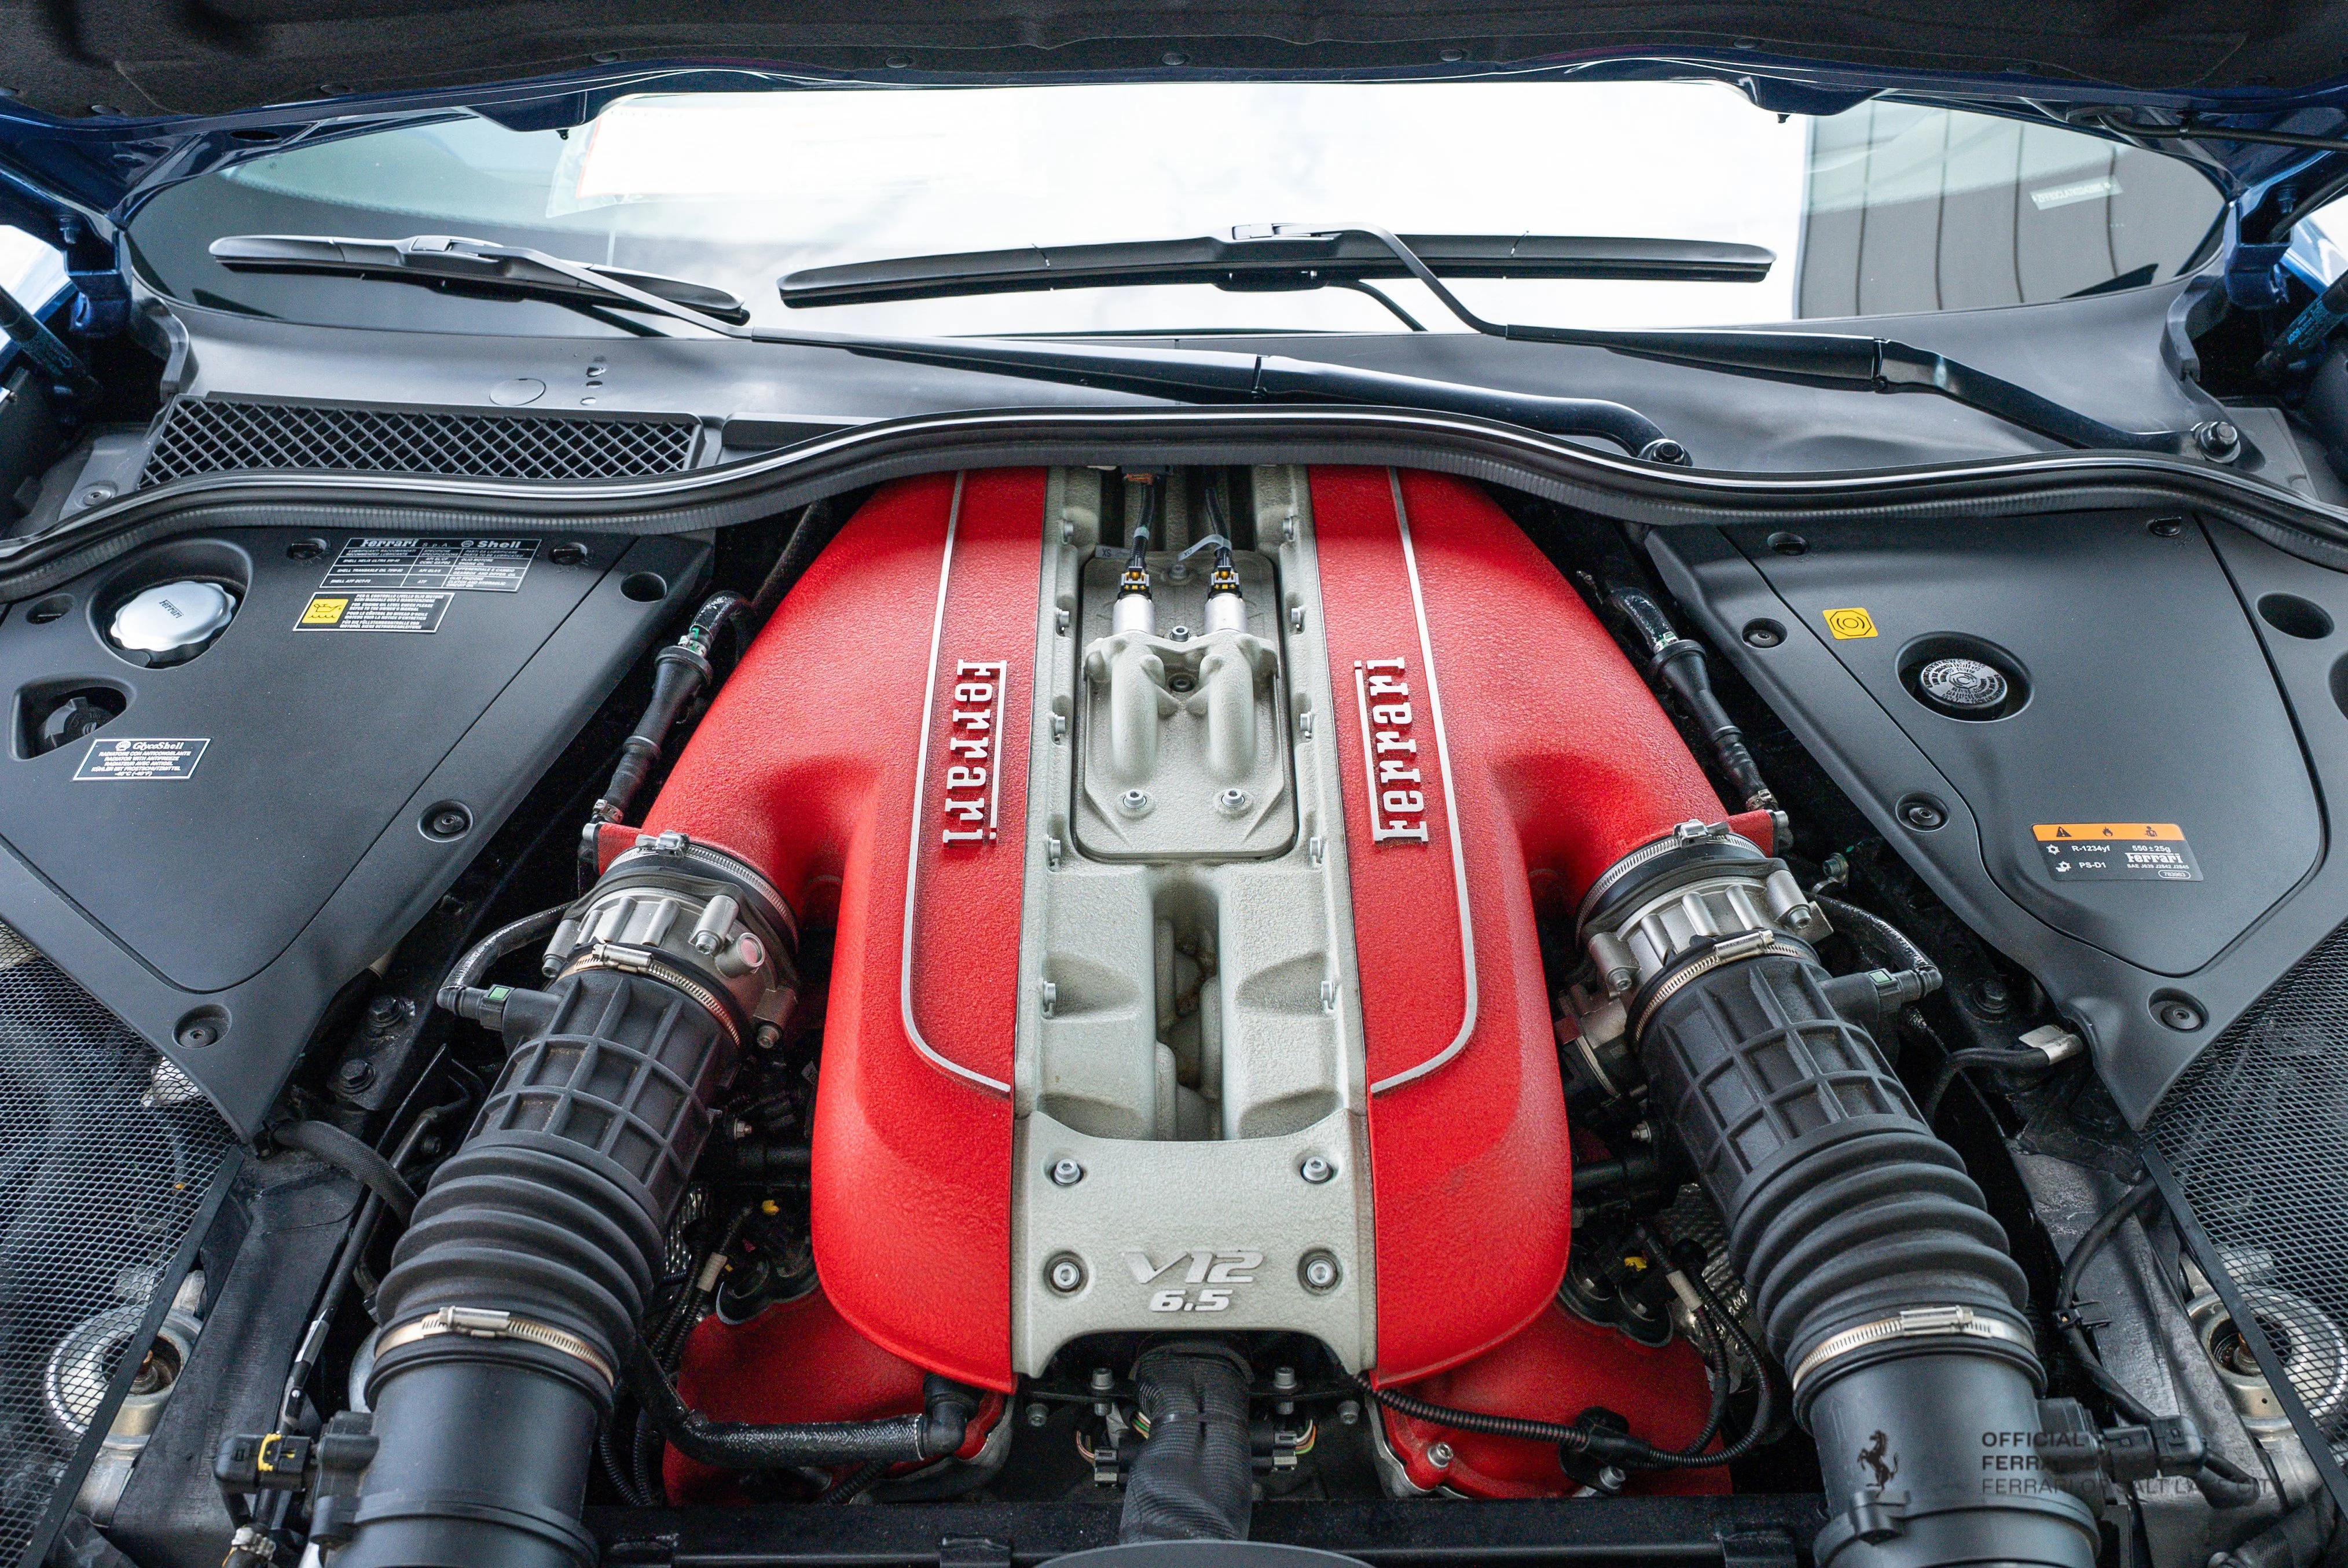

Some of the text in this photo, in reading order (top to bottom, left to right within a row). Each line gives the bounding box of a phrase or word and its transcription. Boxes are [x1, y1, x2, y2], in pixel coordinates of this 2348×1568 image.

[359, 539, 419, 547] Ferrari
[1102, 548, 1111, 557] XS
[159, 598, 184, 619] Ferrari
[133, 741, 185, 751] GlycoShell
[942, 658, 1007, 847] Ferrari
[1353, 656, 1429, 844] Ferrari
[2125, 853, 2184, 863] Ferrari
[1122, 1249, 1265, 1284] V12
[1149, 1288, 1234, 1312] 6.5
